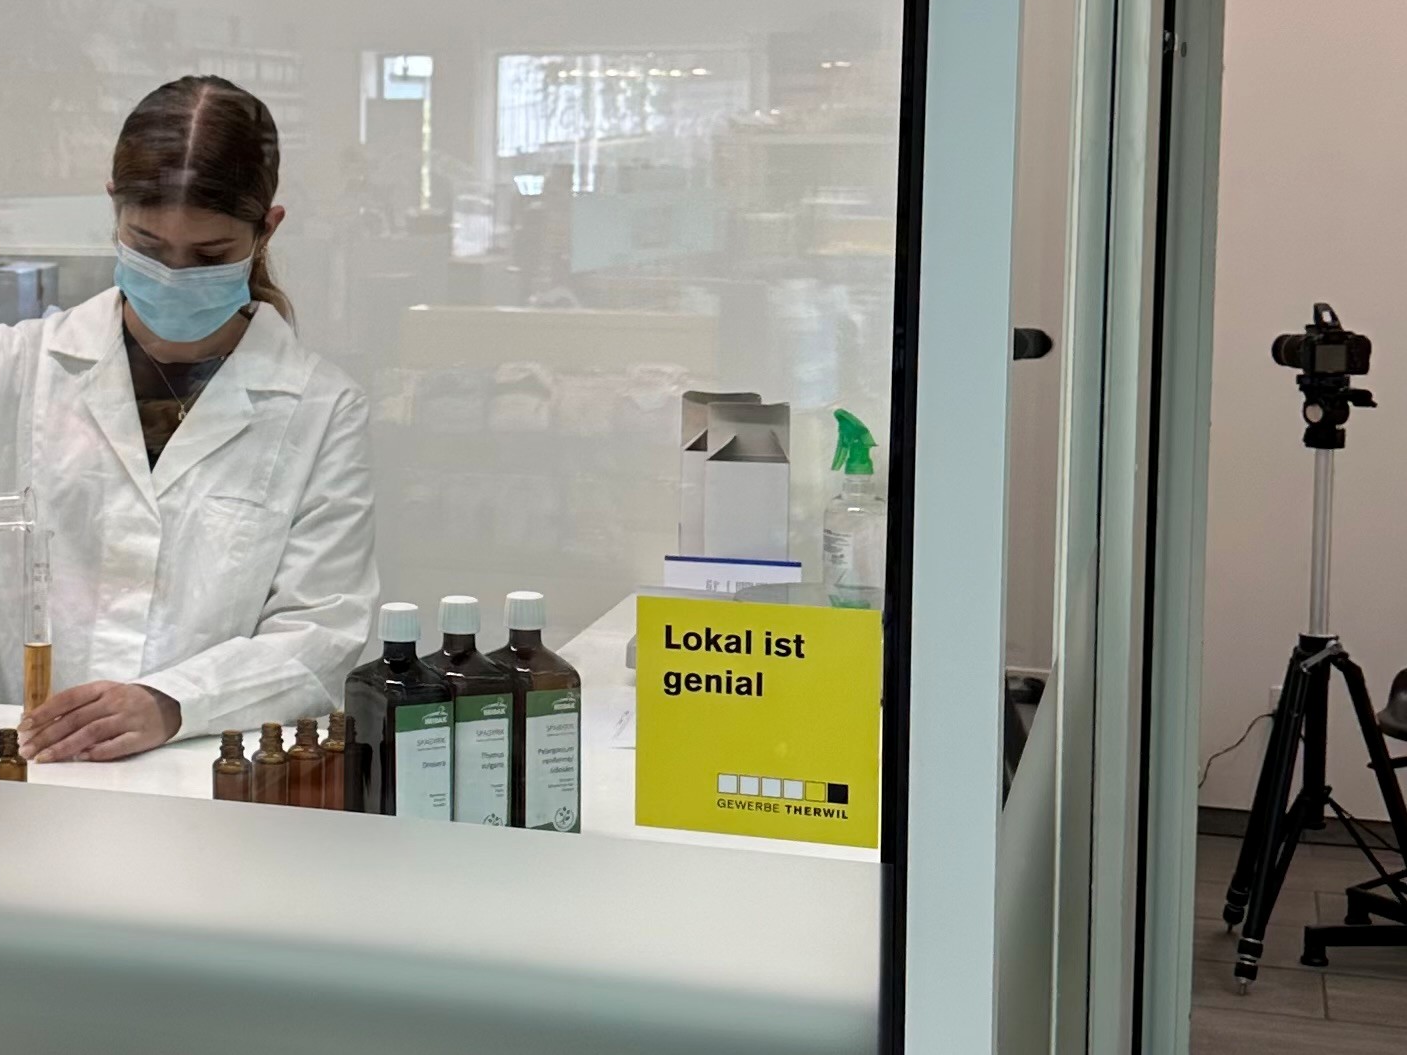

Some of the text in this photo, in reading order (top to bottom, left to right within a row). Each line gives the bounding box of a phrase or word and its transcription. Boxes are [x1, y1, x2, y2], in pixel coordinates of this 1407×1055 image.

[665, 624, 805, 659] Lokal ist
[663, 670, 763, 697] genial
[717, 798, 848, 820] GEWERBE THERWIL
